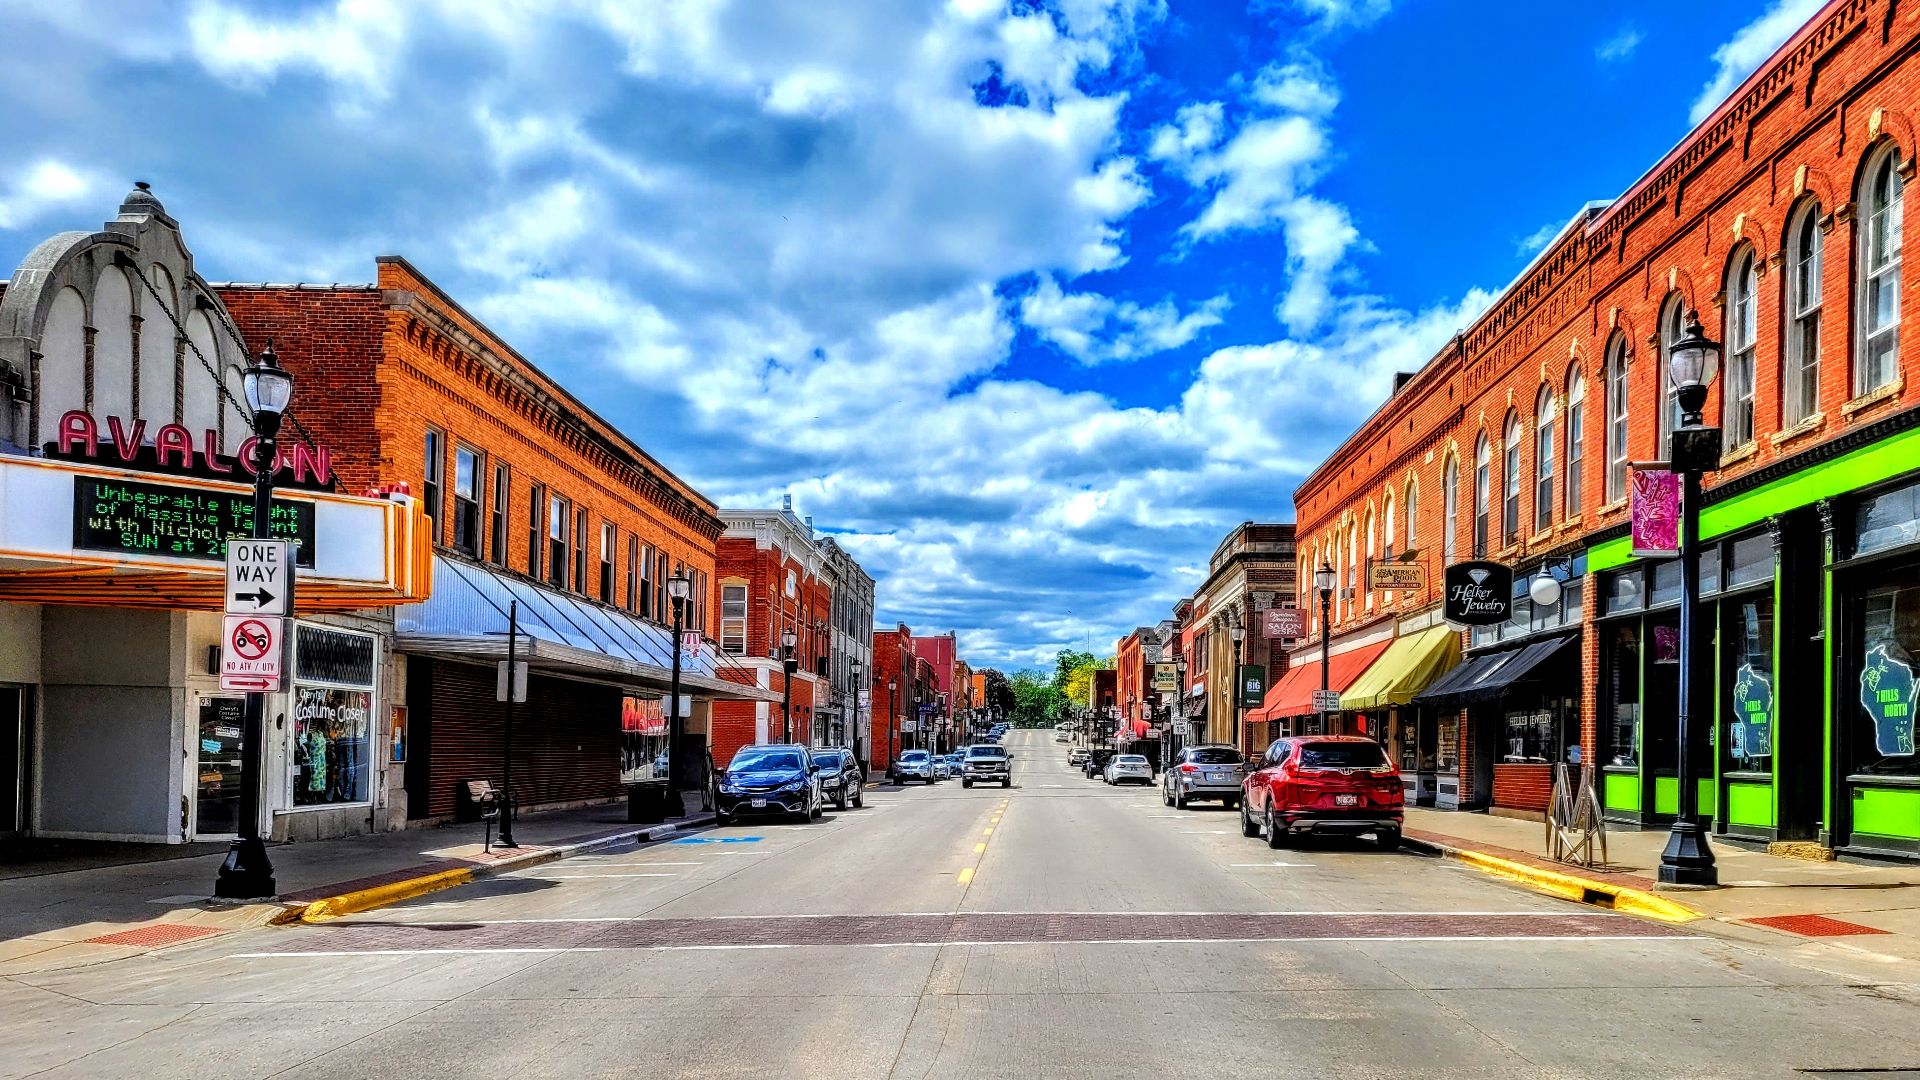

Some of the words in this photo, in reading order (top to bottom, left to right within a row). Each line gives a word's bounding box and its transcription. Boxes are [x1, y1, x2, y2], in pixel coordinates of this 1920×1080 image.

[58, 409, 330, 485] AVALON
[96, 484, 219, 511] Unbearable
[231, 499, 297, 520] Weght
[89, 515, 139, 532] with
[96, 501, 120, 515] of
[134, 503, 219, 525] Massive
[231, 514, 297, 534] Taent
[120, 532, 158, 549] SUN
[171, 538, 194, 552] at
[238, 545, 277, 562] ONE
[236, 565, 277, 582] WAY
[1386, 568, 1420, 576] AMERICAN
[1393, 574, 1417, 583] ROOTS
[1450, 583, 1493, 601] Helker
[1459, 597, 1506, 616] Jewelry
[1268, 622, 1302, 630] SALON
[226, 661, 236, 671] NO
[239, 661, 252, 671] ATV
[262, 662, 275, 672] UTV
[1247, 681, 1261, 690] BIG
[1875, 690, 1880, 703] 7
[1880, 688, 1899, 703] HILLS
[295, 699, 336, 721] Costume
[337, 704, 365, 723] Closet
[1750, 712, 1767, 724] NORTH
[1884, 703, 1908, 717] NORTH
[1529, 713, 1552, 727] JEWELRY
